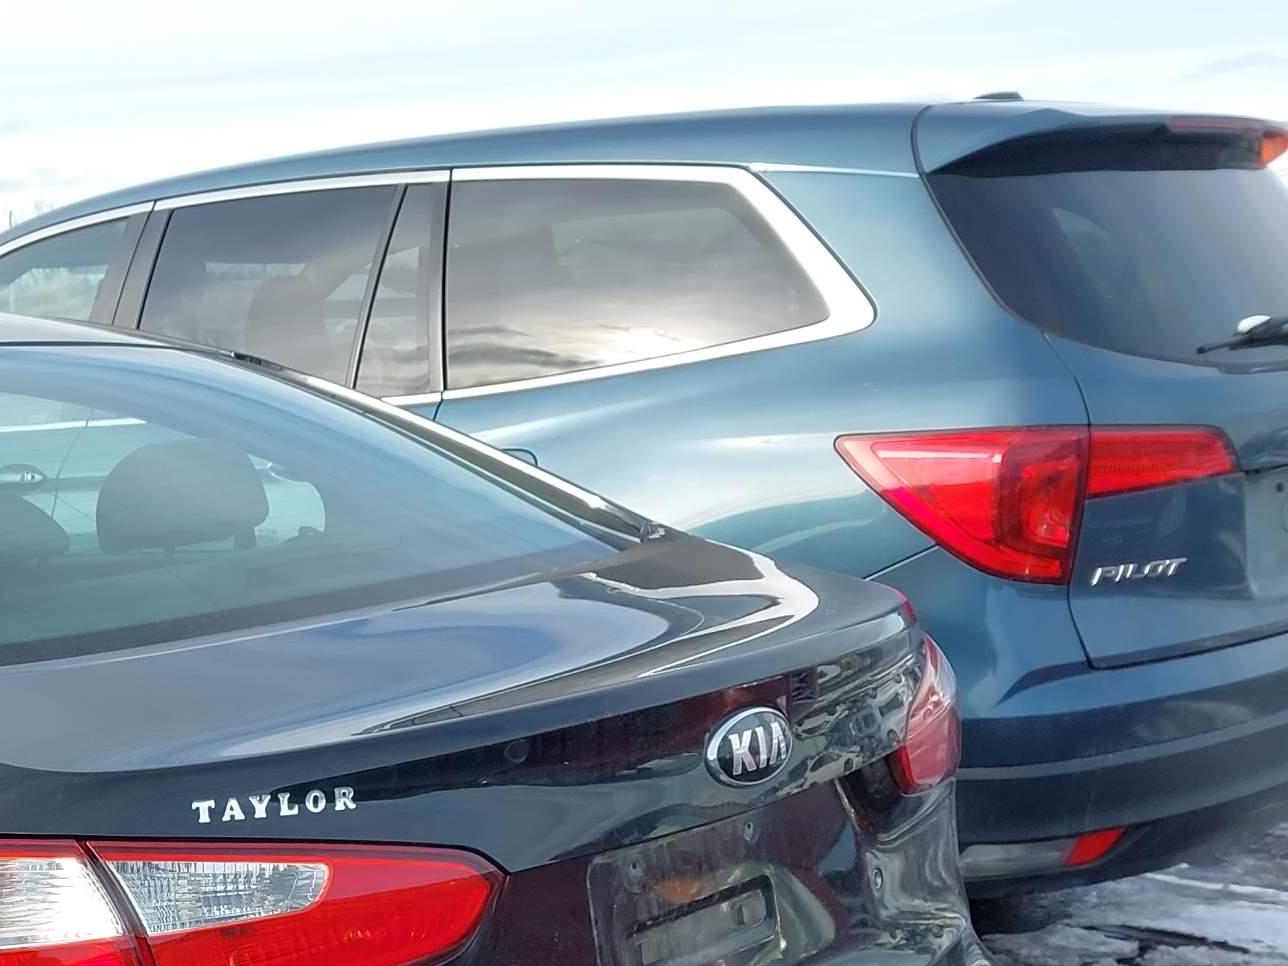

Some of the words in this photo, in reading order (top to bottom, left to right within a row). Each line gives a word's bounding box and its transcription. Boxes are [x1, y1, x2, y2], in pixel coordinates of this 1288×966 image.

[1091, 557, 1188, 586] PILOT
[728, 721, 787, 776] KIA
[191, 786, 357, 824] TAYLOR
